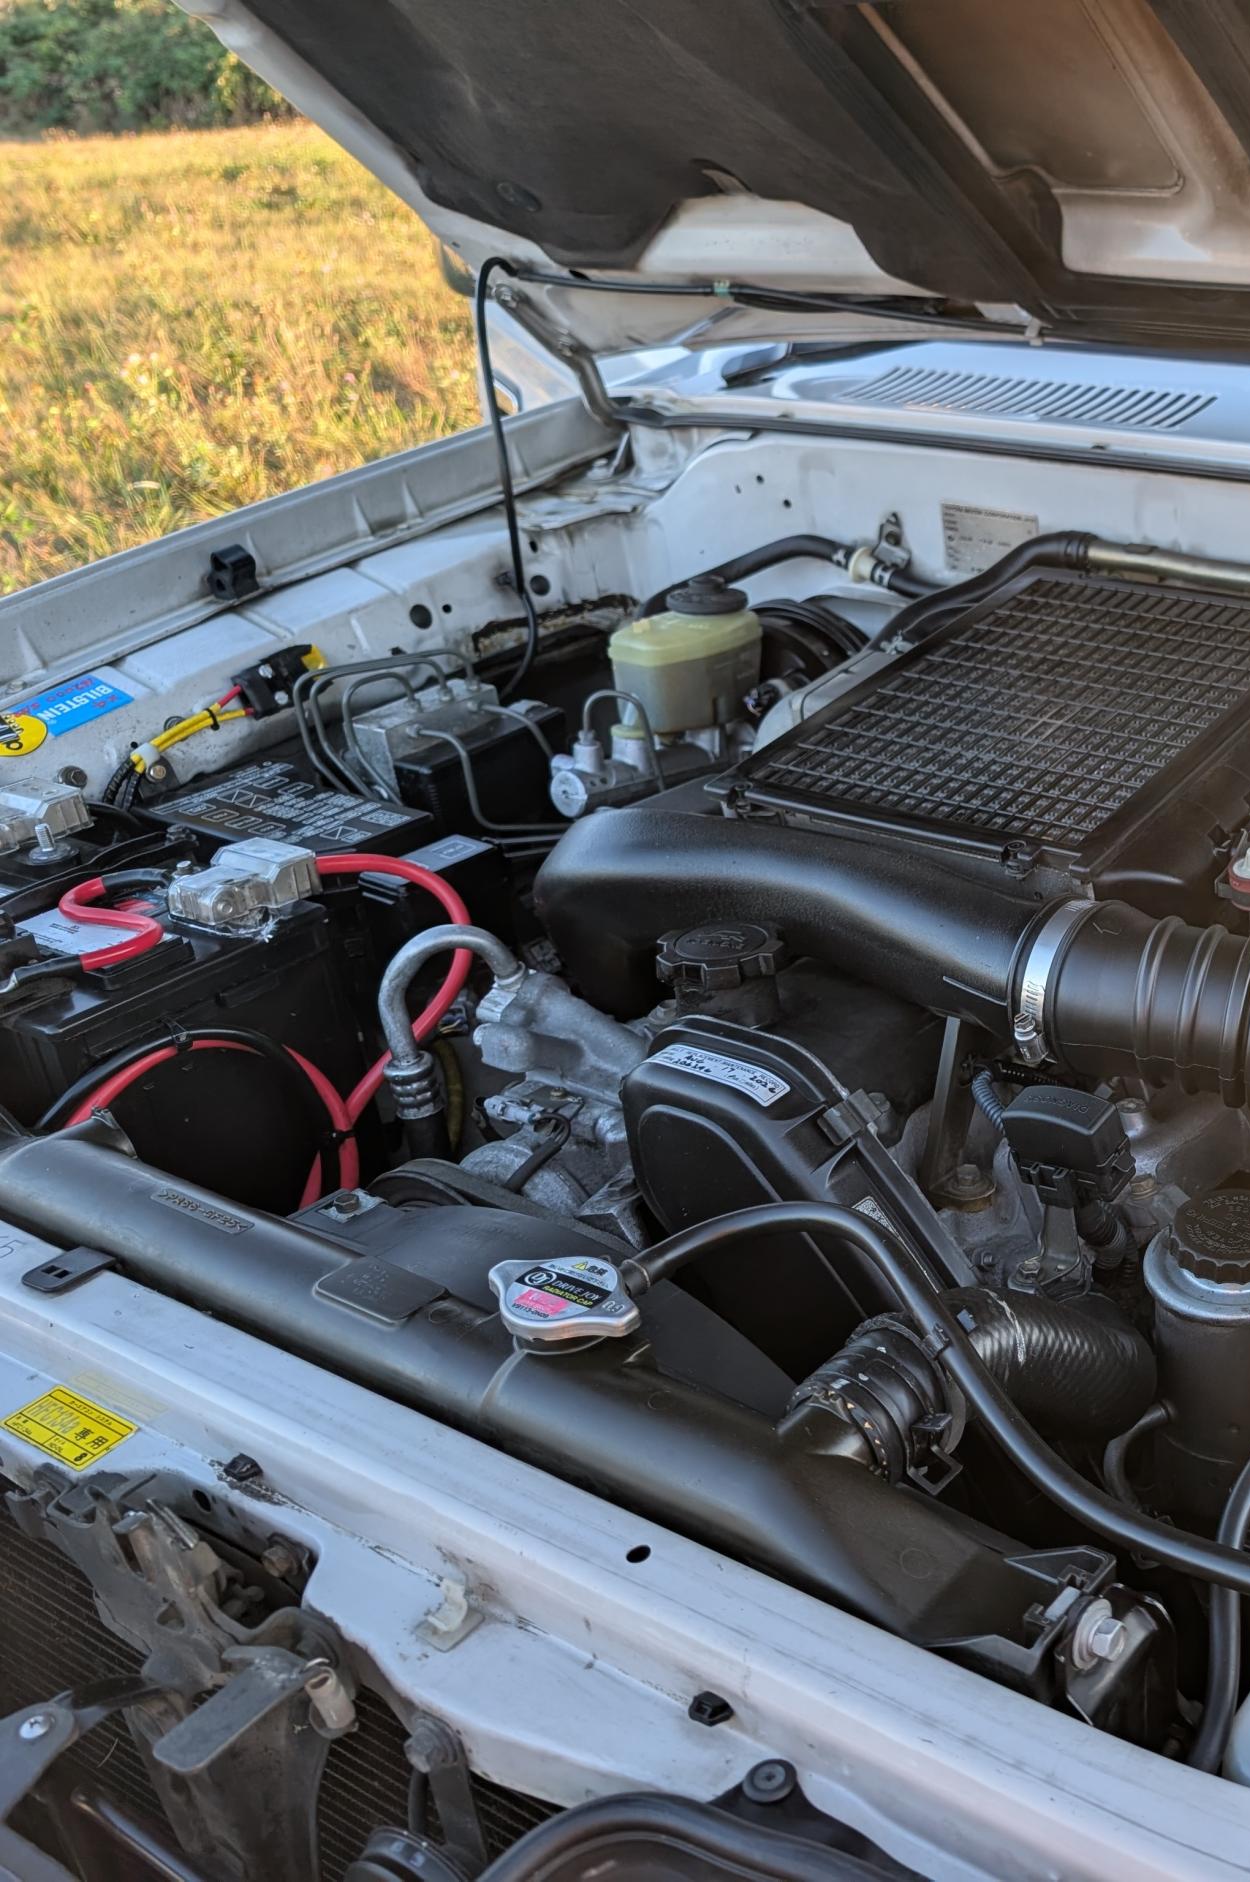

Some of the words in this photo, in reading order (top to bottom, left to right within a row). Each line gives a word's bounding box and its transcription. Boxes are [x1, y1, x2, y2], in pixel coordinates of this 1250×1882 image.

[37, 684, 113, 720] BILSTEIN
[542, 1285, 579, 1303] RADIATOR
[576, 1296, 594, 1306] CAP
[551, 1279, 584, 1296] DRIVE
[582, 1290, 602, 1302] JOY
[74, 1426, 110, 1450] 専用
